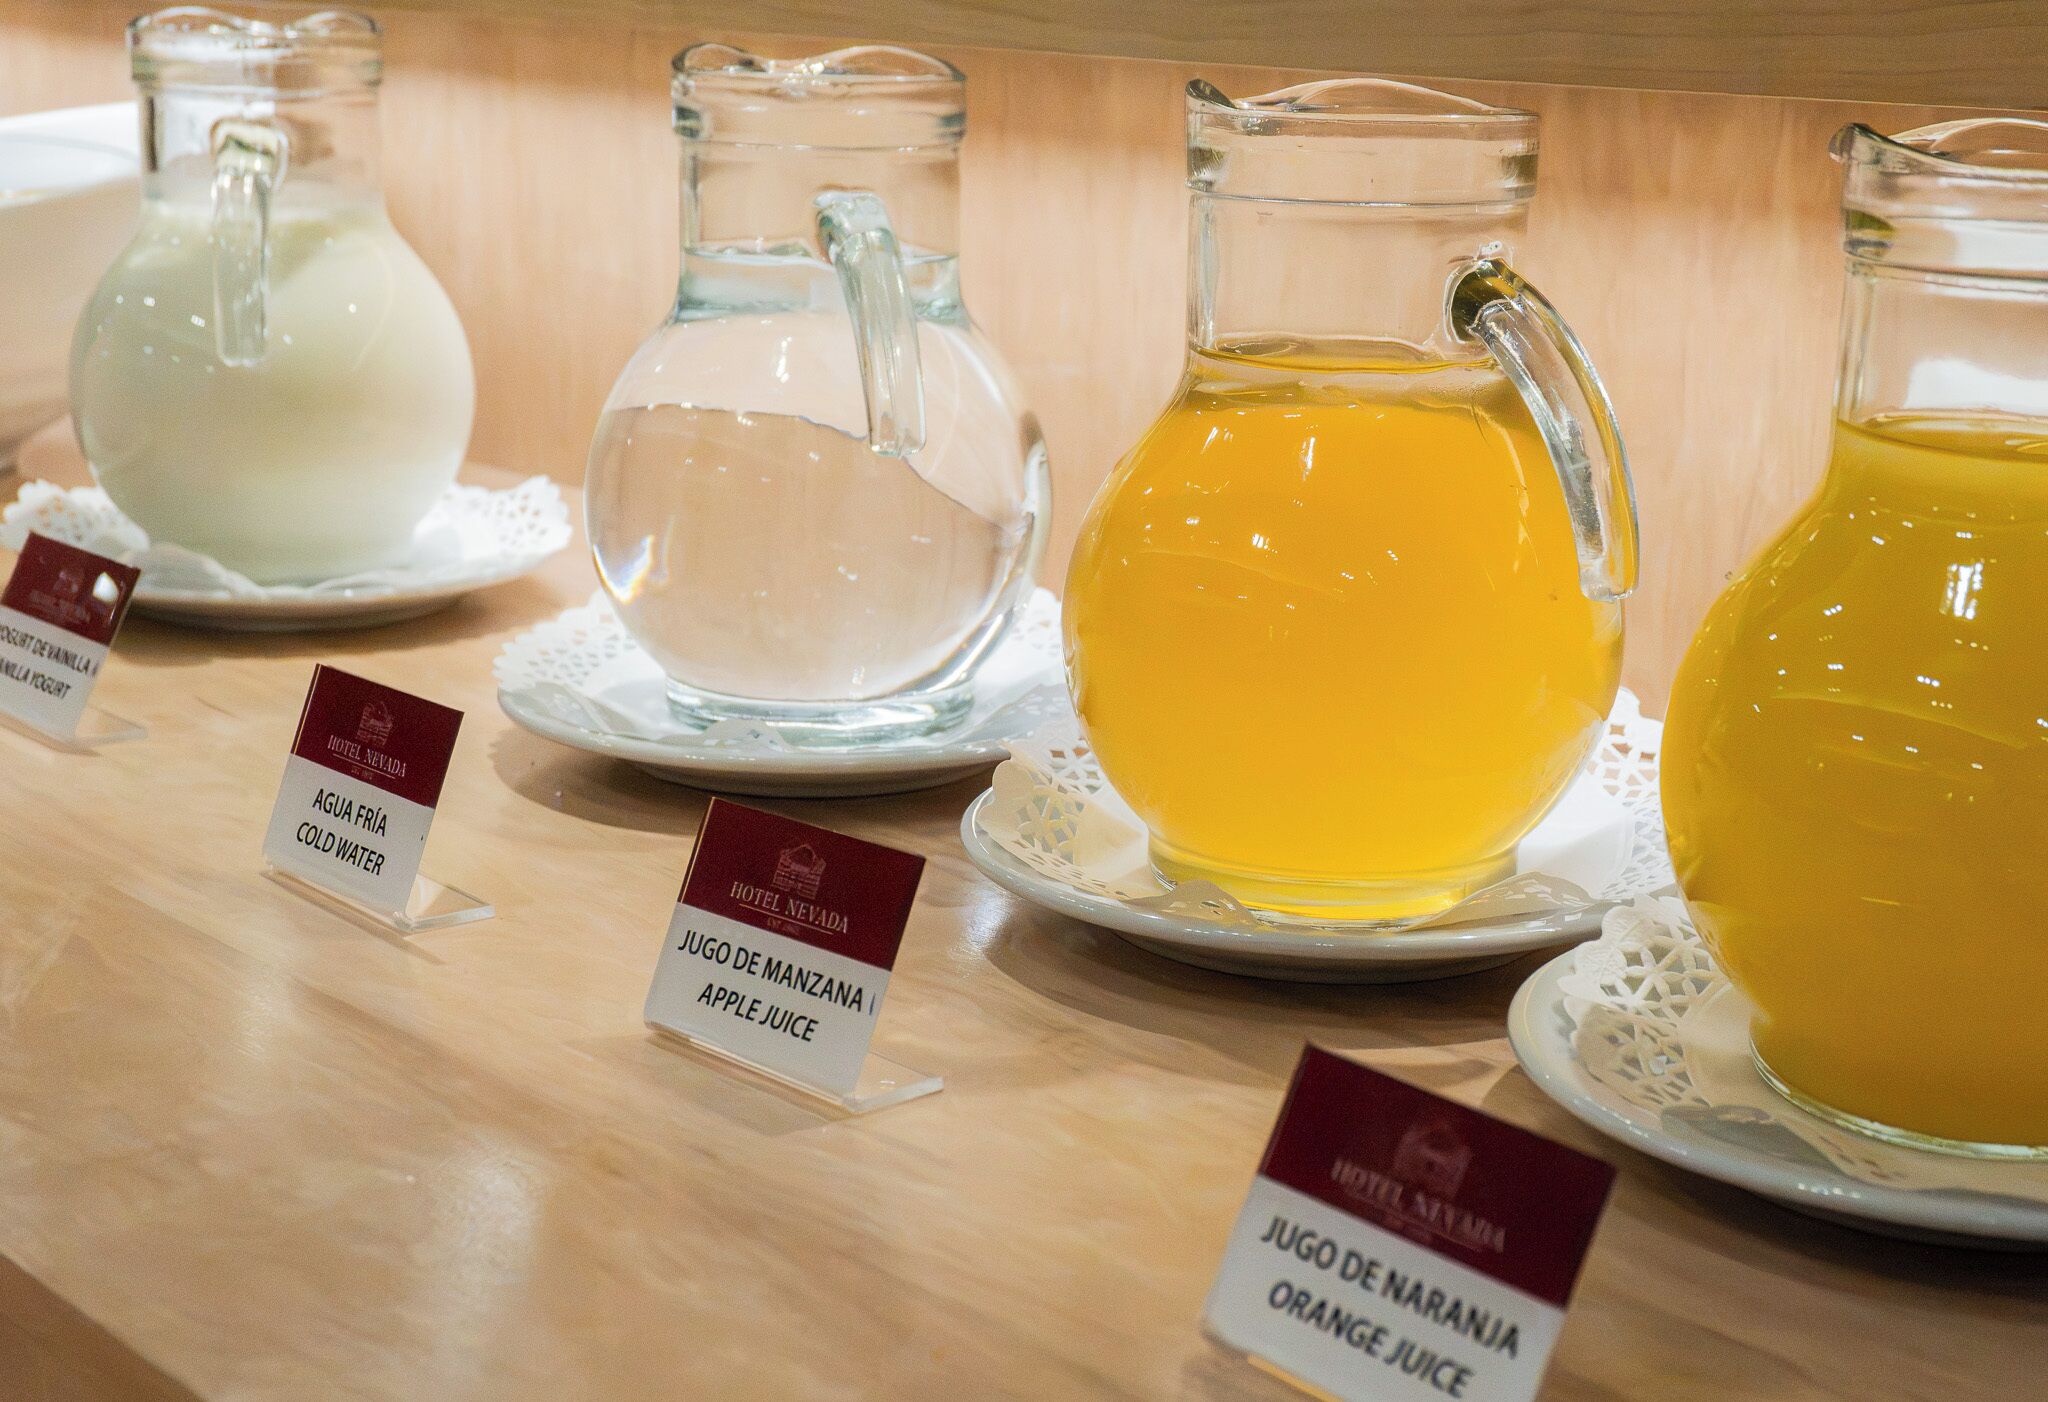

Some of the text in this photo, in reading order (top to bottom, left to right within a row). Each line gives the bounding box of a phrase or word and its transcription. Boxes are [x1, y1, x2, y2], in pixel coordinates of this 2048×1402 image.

[0, 625, 91, 675] OGURT DE VAINILLA
[0, 658, 71, 699] ANILLA YOGURT
[327, 734, 361, 760] HOTEL
[363, 748, 406, 777] NEVADA
[312, 788, 387, 837] AGUA FRÍA
[296, 822, 385, 876] COLD WATER
[730, 881, 780, 912] HOTEL
[784, 896, 848, 934] NEVADA
[678, 929, 863, 1013] JUGO DE MANZANA
[697, 983, 820, 1042] APPLE JUICE
[1260, 1215, 1338, 1271] JUGO
[1339, 1249, 1383, 1293] DE
[1381, 1268, 1520, 1361] NARANJA
[1268, 1280, 1475, 1400] ORANGE JUICE
